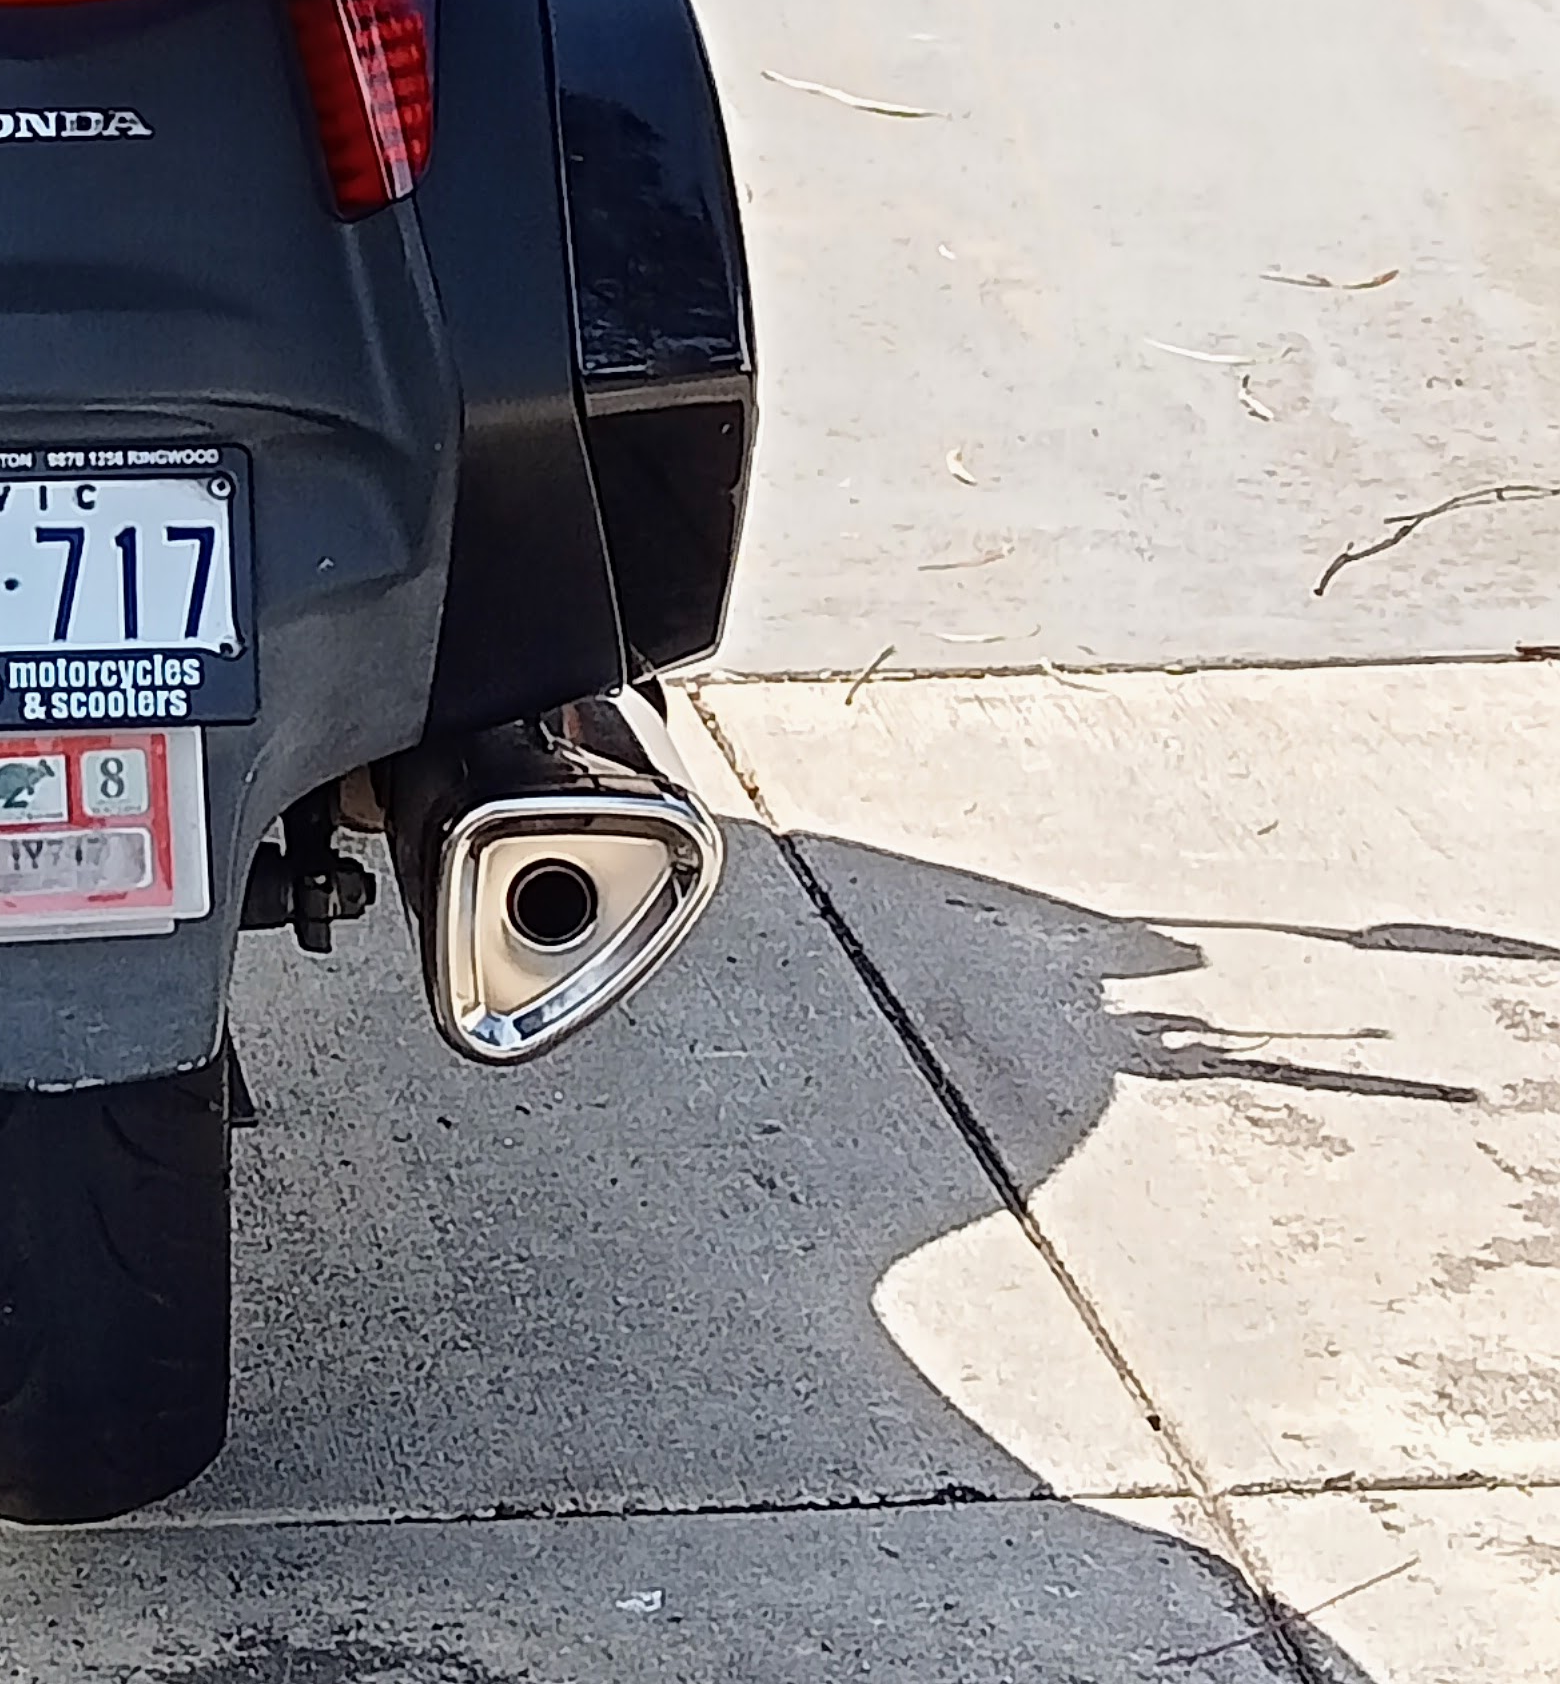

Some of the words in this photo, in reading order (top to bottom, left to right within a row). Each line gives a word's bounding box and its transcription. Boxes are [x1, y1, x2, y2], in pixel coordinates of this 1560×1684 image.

[127, 449, 219, 465] RINGWOOD
[9, 655, 200, 689] motorcycles
[23, 692, 46, 720] &
[50, 687, 188, 718] scooters
[99, 756, 125, 799] 8
